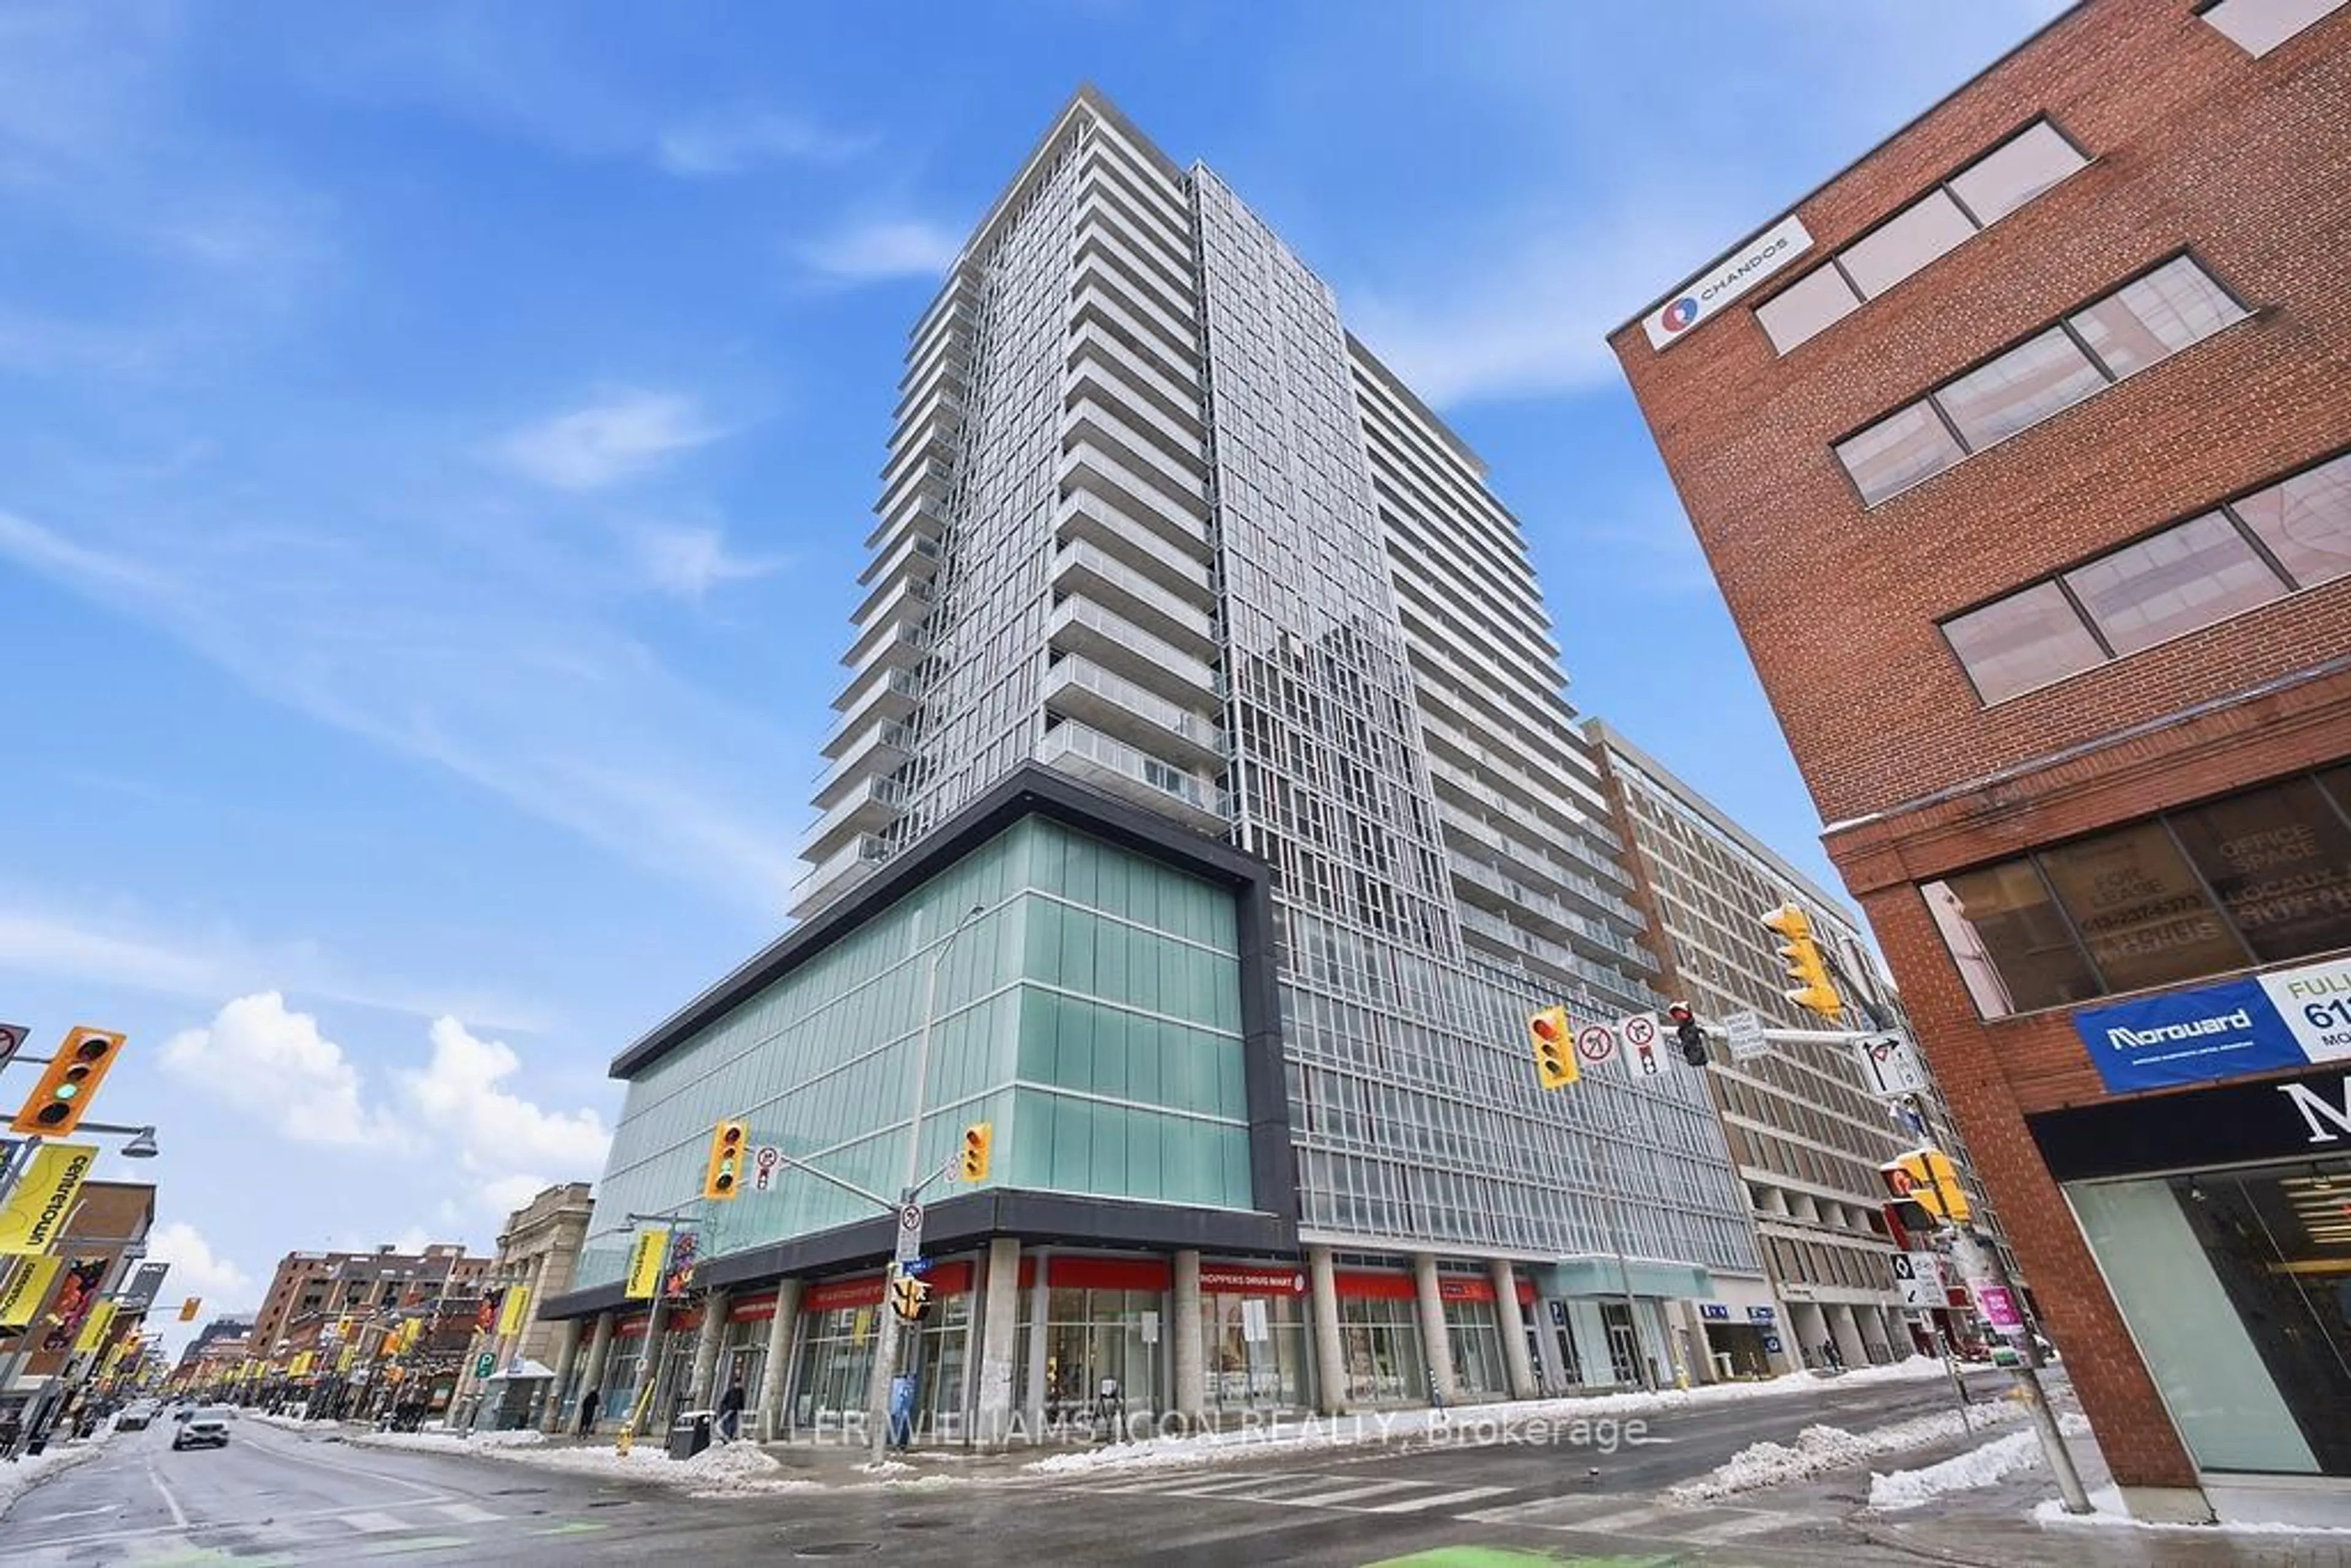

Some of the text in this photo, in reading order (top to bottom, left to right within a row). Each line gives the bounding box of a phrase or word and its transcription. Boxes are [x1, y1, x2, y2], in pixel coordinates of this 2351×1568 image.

[1700, 238, 1788, 301] CHANDOS
[2107, 1008, 2254, 1050] Morguard
[26, 1155, 88, 1245] centretown
